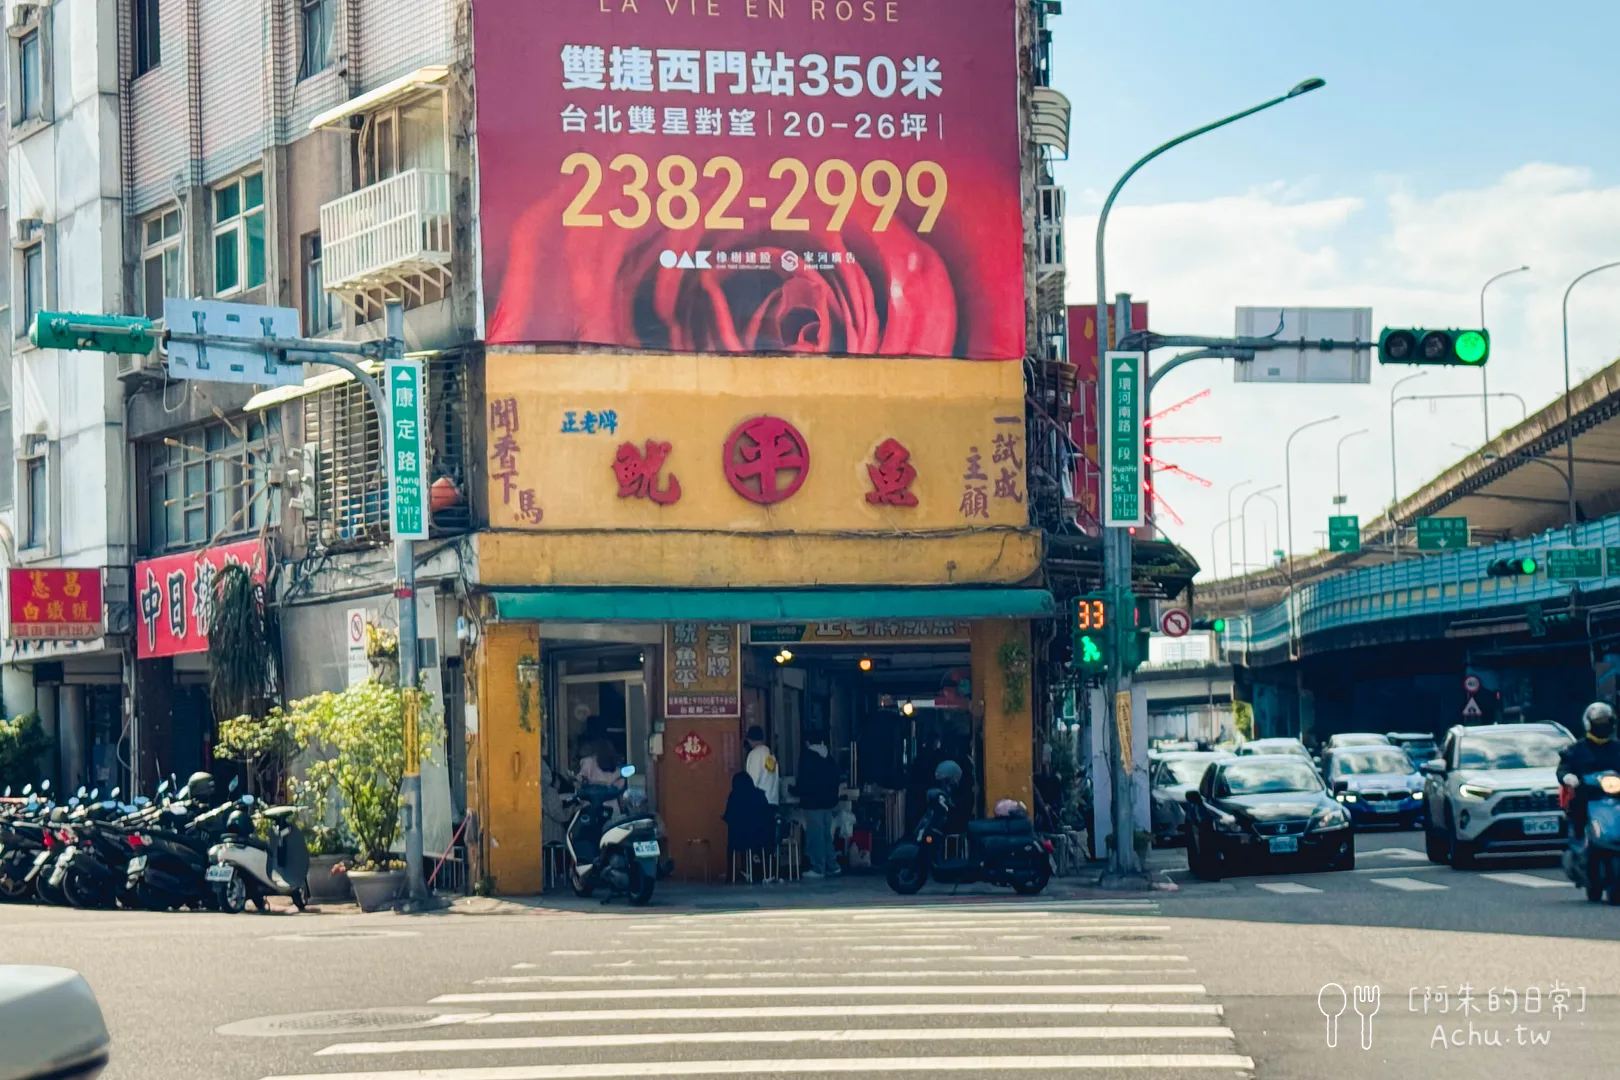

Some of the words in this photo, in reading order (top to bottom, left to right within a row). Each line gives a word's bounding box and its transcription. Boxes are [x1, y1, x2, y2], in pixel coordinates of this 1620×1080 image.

[600, 0, 638, 13] LA
[665, 0, 720, 16] VIE
[747, 0, 784, 19] EN
[811, 0, 899, 22] ROSE
[560, 44, 943, 100] 雙捷西門站350米
[560, 104, 756, 137] 台北雙星對望
[783, 111, 928, 141] 20-26坪
[560, 152, 948, 233] 2382-2999
[396, 387, 416, 472] 康定路
[560, 409, 618, 435] 正老牌
[1117, 377, 1131, 461] 環河南路一段
[490, 397, 544, 524] 聞香下馬
[396, 475, 419, 486] Kang
[397, 485, 418, 497] Ding
[1079, 600, 1104, 629] 33
